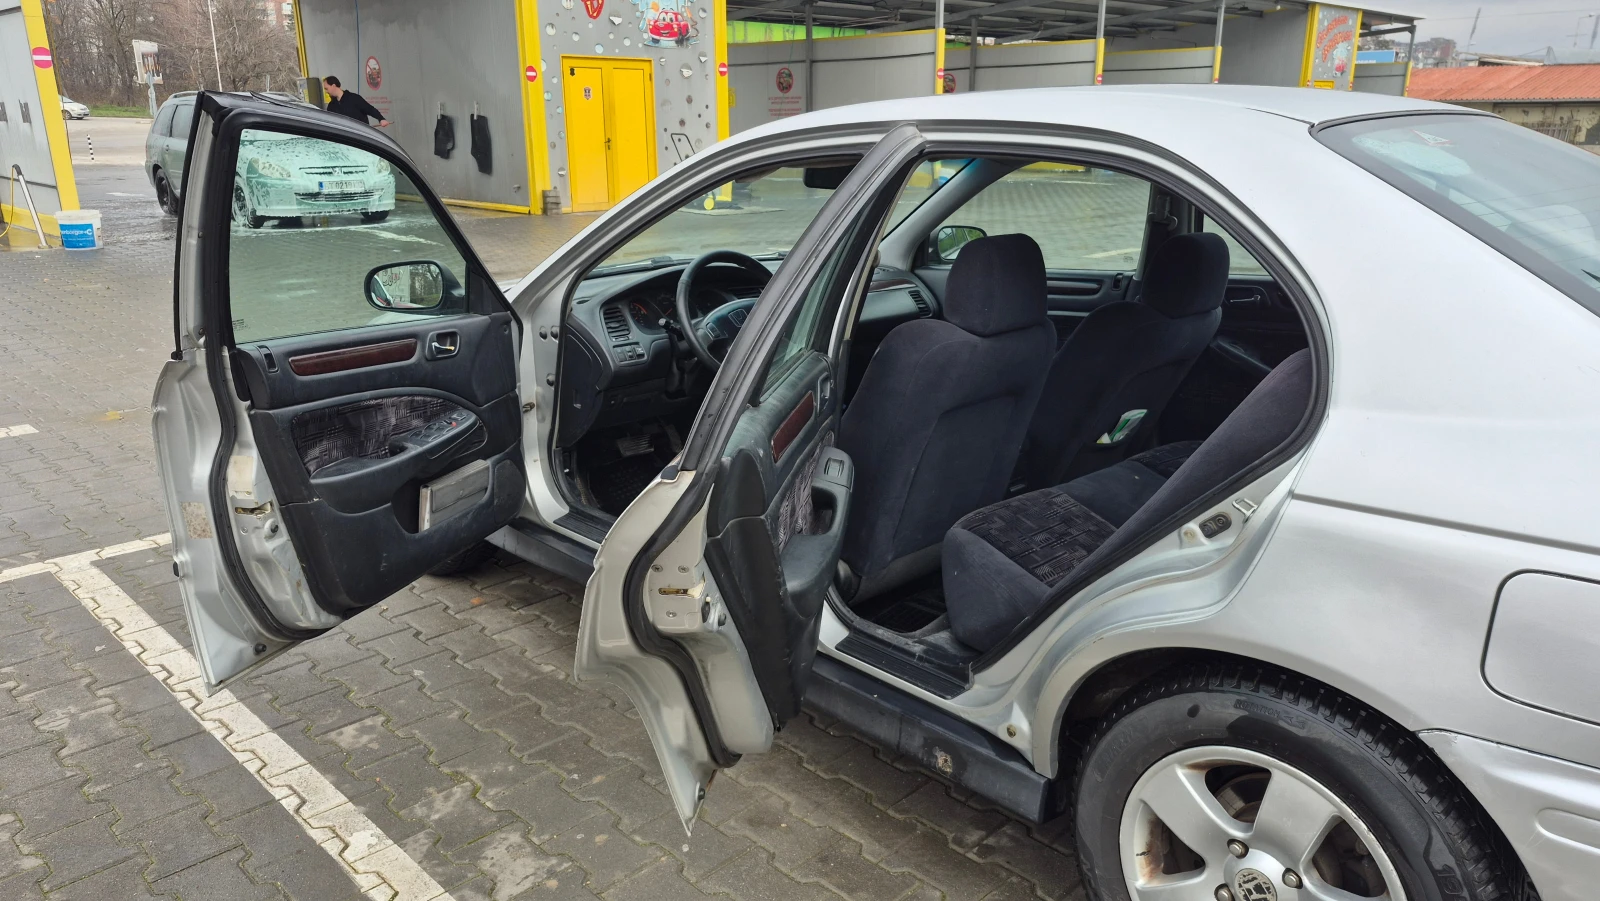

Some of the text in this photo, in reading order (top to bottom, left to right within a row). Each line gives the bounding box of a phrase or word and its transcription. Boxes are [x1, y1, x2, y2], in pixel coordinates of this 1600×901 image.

[335, 181, 353, 190] 0219
[1234, 699, 1281, 718] ROTATION
[1437, 863, 1467, 901] 19
